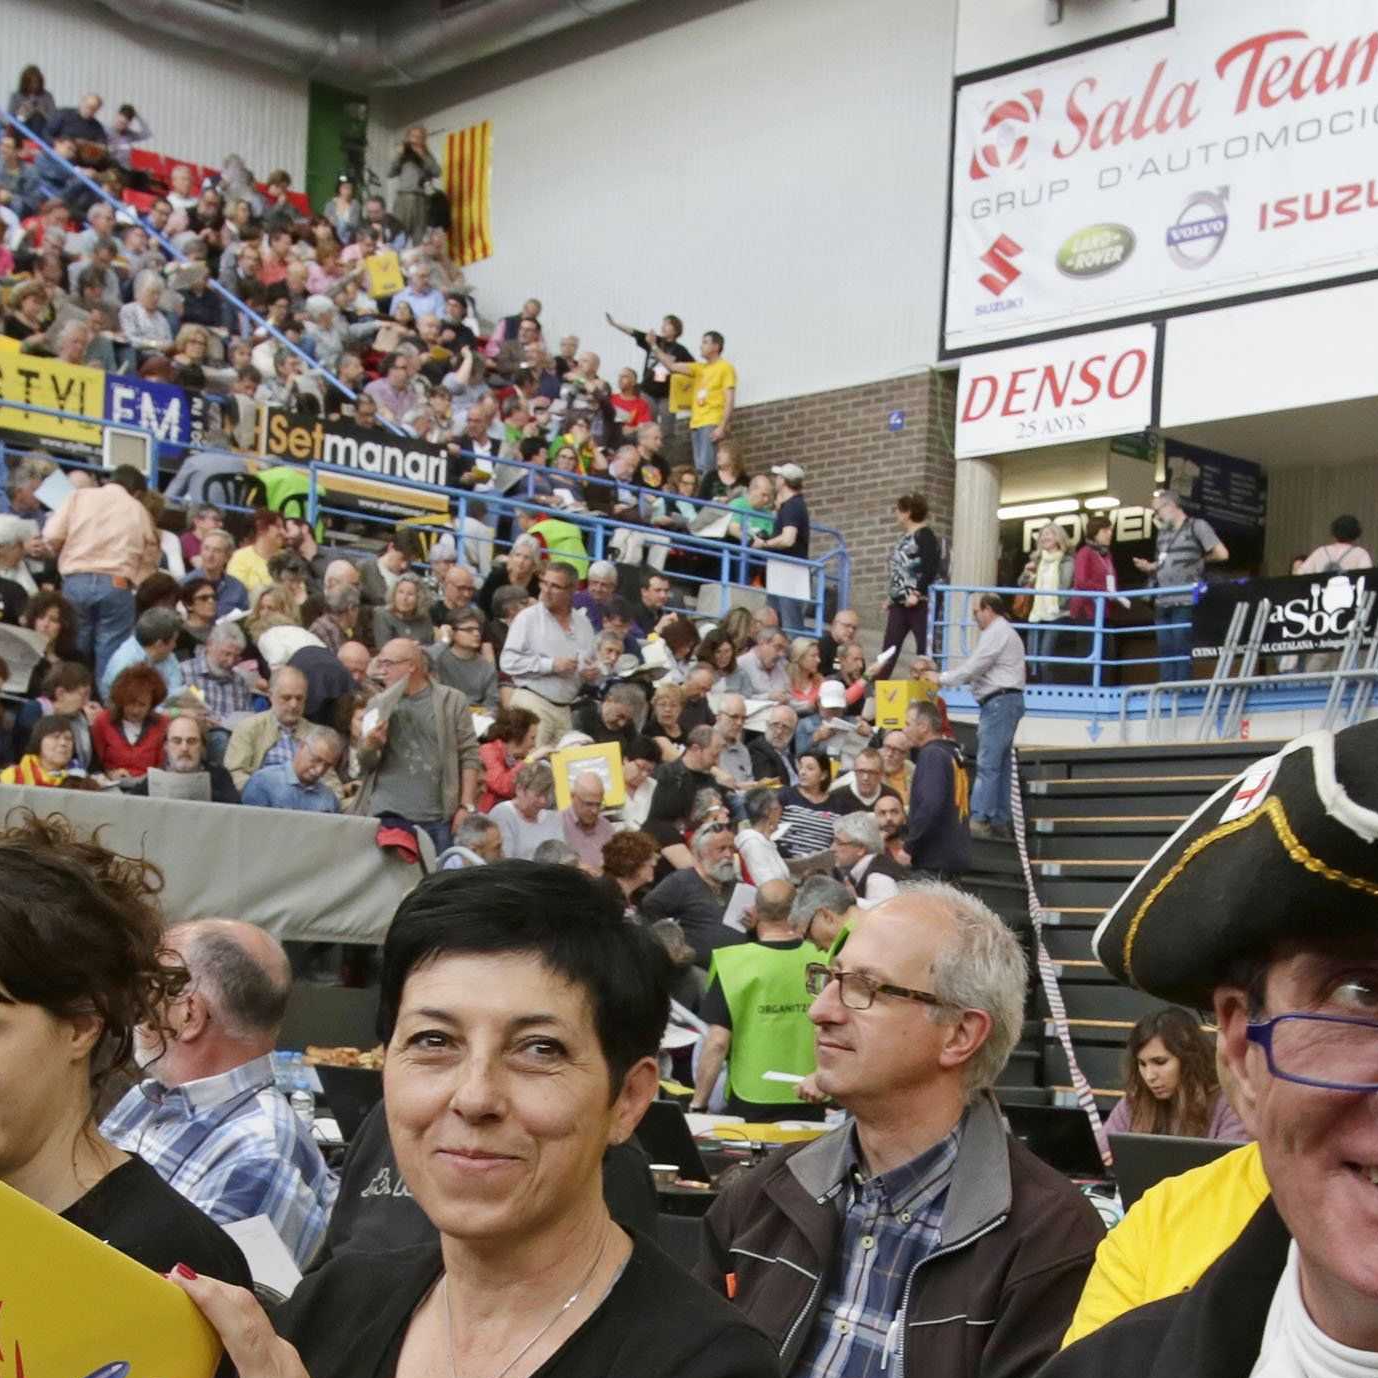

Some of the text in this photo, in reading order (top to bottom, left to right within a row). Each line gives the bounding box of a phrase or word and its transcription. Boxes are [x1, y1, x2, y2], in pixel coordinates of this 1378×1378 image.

[1051, 58, 1201, 160] Sala
[970, 178, 1071, 221] GRUP
[1169, 218, 1226, 242] VOLVO
[974, 297, 1024, 318] SUZUKI
[960, 349, 1148, 423] DENSO
[1015, 415, 1088, 439] 25 ANYS
[268, 414, 449, 486] Setmanari
